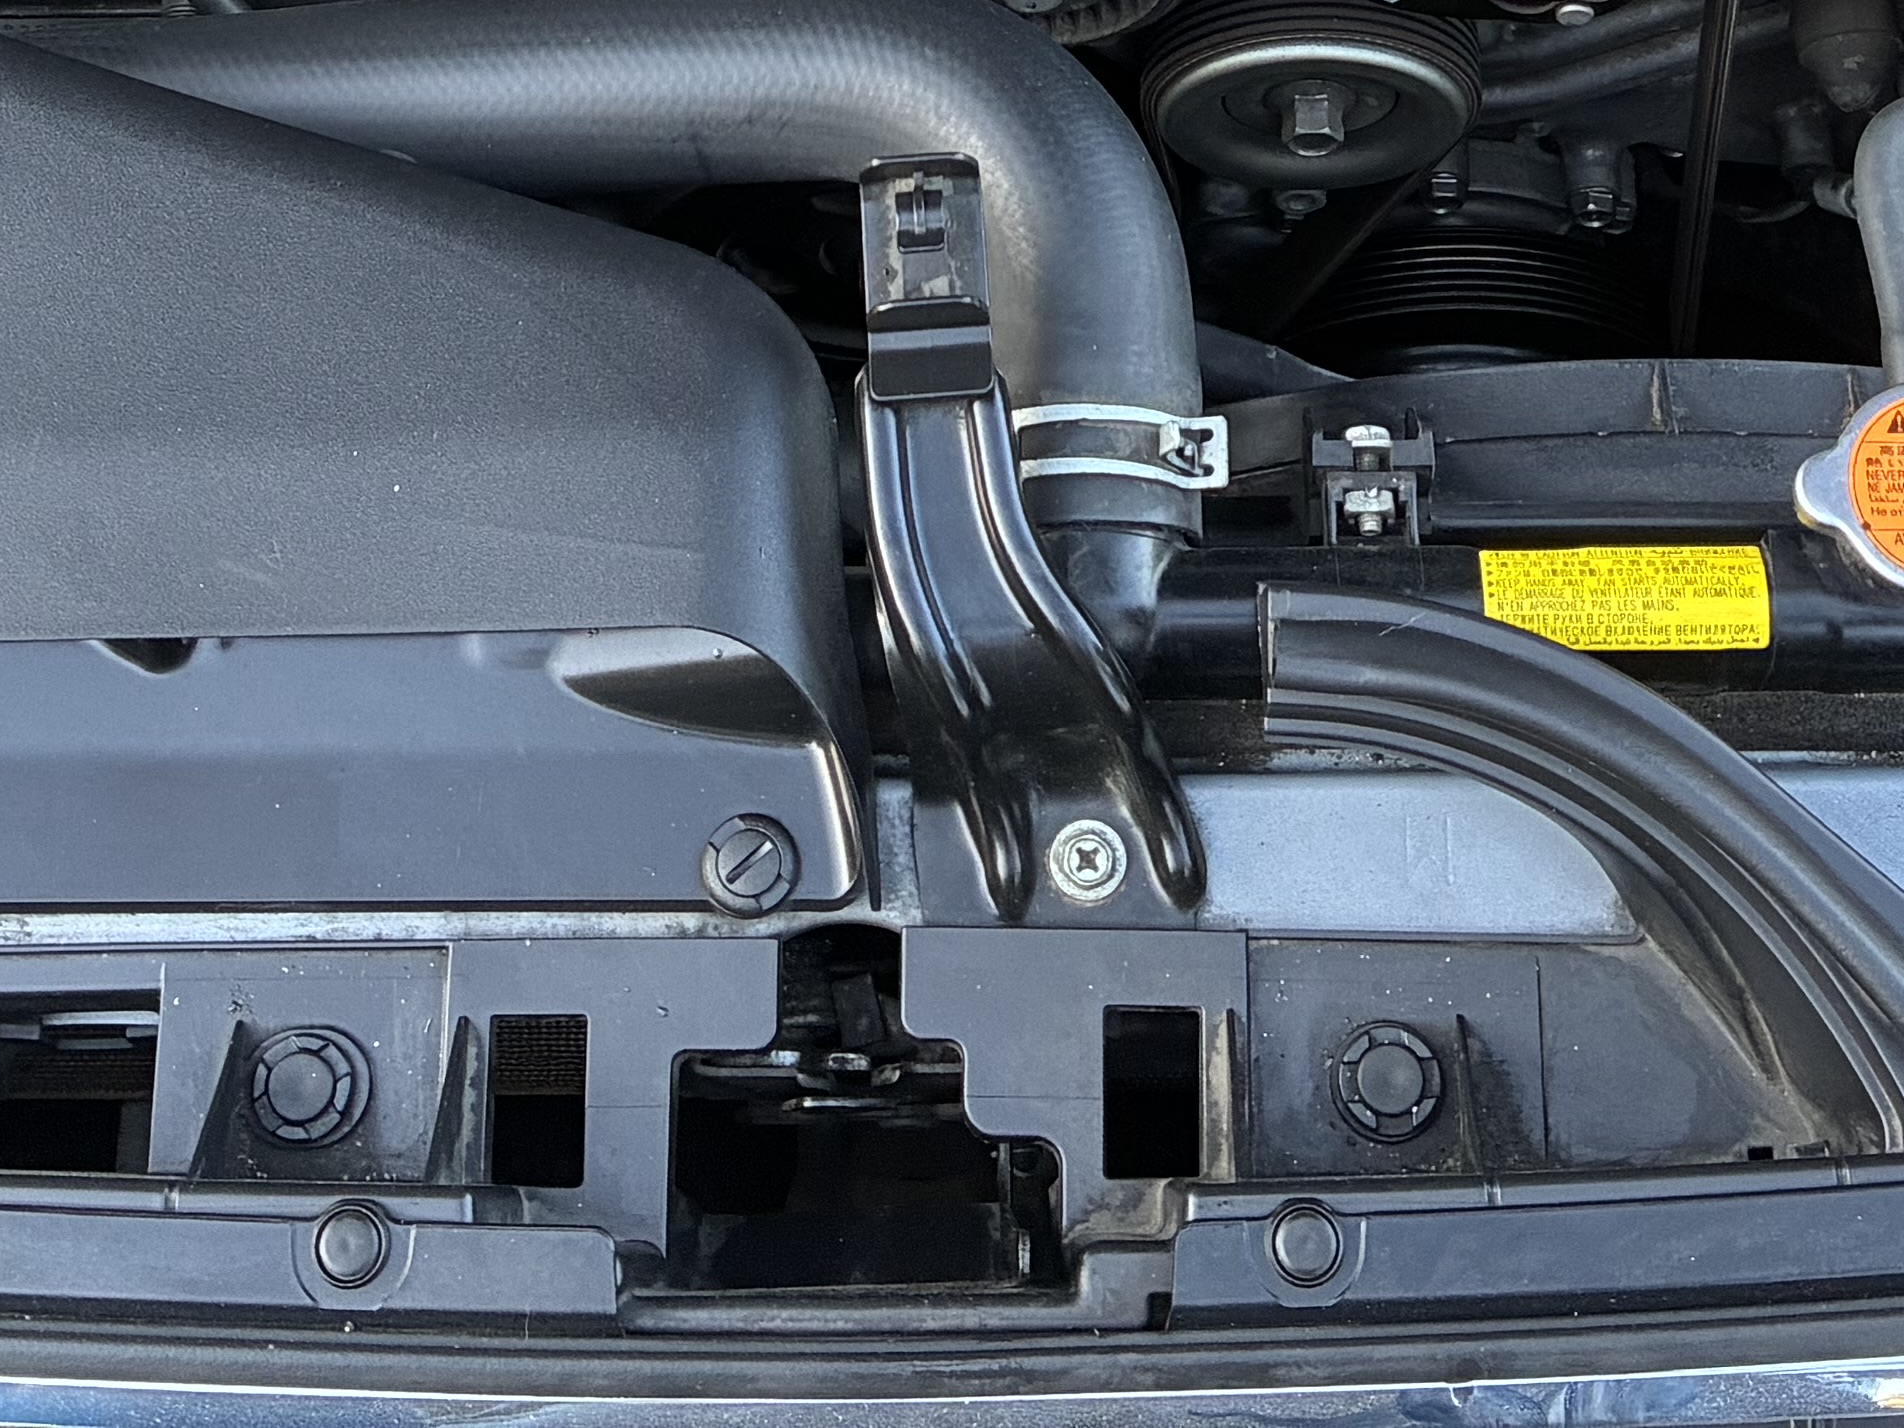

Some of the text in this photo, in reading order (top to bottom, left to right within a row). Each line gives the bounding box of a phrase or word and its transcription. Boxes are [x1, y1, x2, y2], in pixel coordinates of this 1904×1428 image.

[1867, 482, 1879, 493] NE
[1495, 580, 1520, 588] KEEP
[1597, 577, 1615, 587] FAN
[1620, 576, 1657, 586] STARTS
[1497, 589, 1507, 600] LE
[1590, 586, 1652, 598] VENTILATEUR
[1497, 598, 1679, 612] N'EN APPROCHEZ PAS LES MAINS.
[1553, 613, 1582, 624] РУКИ
[1586, 612, 1593, 623] В
